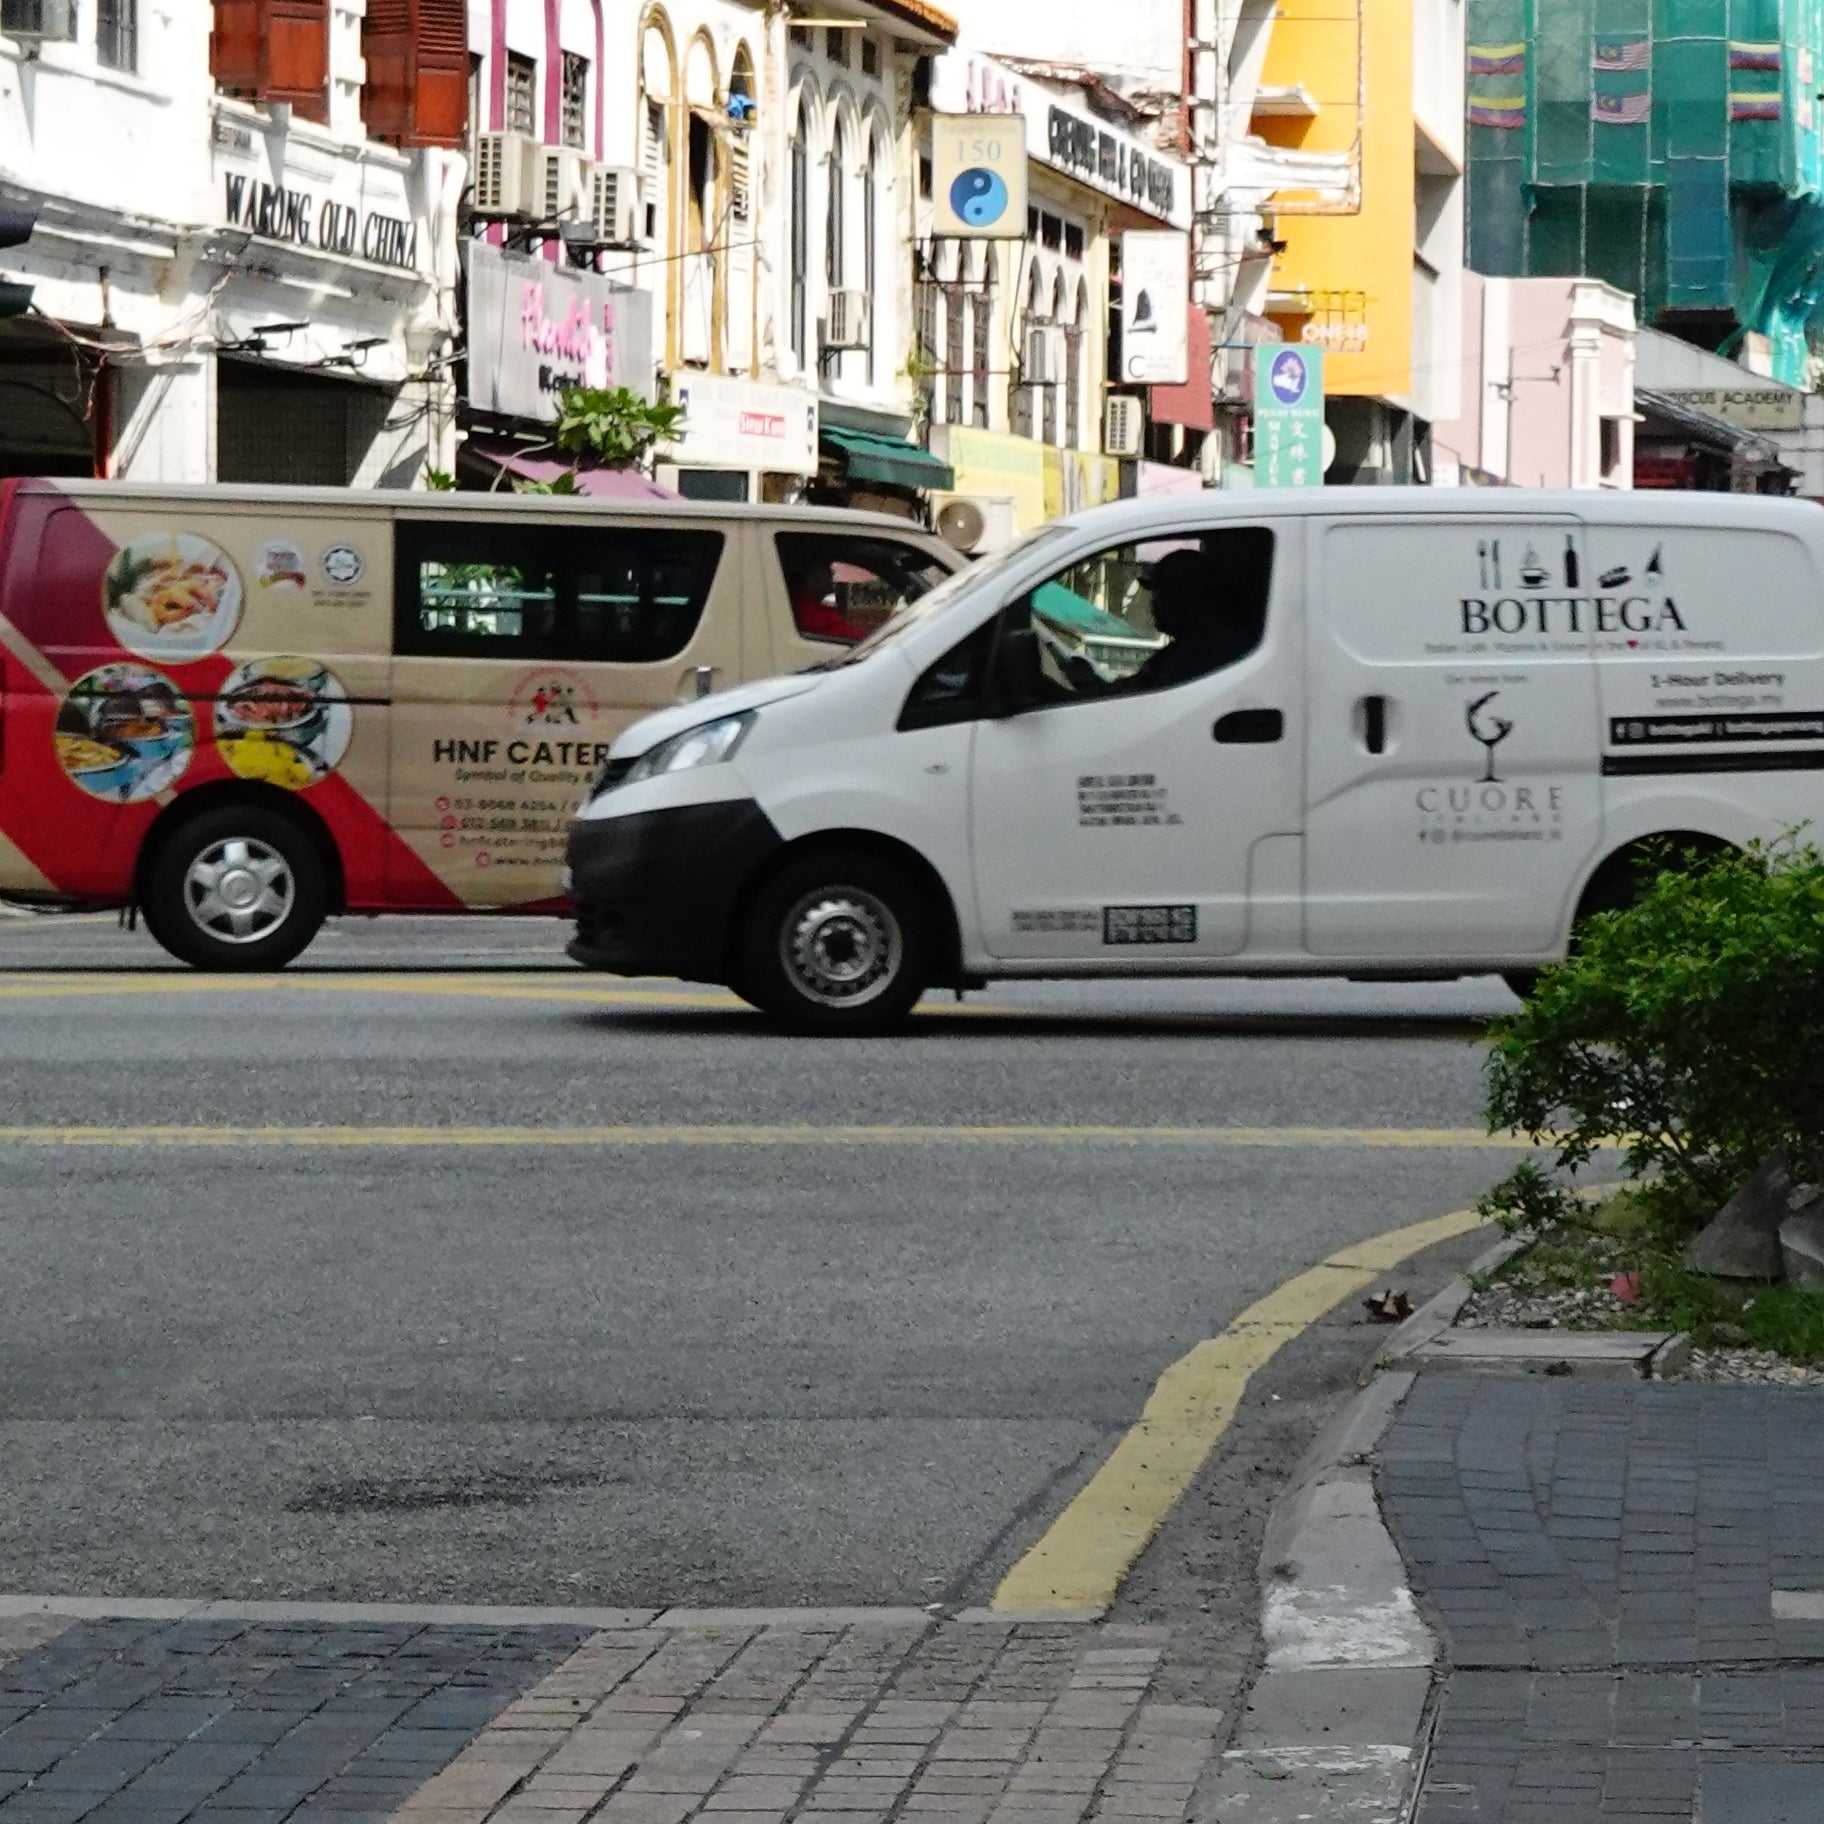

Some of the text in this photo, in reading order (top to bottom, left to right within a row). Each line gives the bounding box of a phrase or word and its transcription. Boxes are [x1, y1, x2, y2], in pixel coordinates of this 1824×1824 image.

[957, 139, 1002, 163] 150
[225, 171, 419, 272] WARONG OLD CHINA
[1723, 392, 1794, 406] ACADEMY
[1460, 597, 1688, 634] BOTTEGA
[433, 738, 499, 764] HNF
[1415, 786, 1561, 812] CUORE
